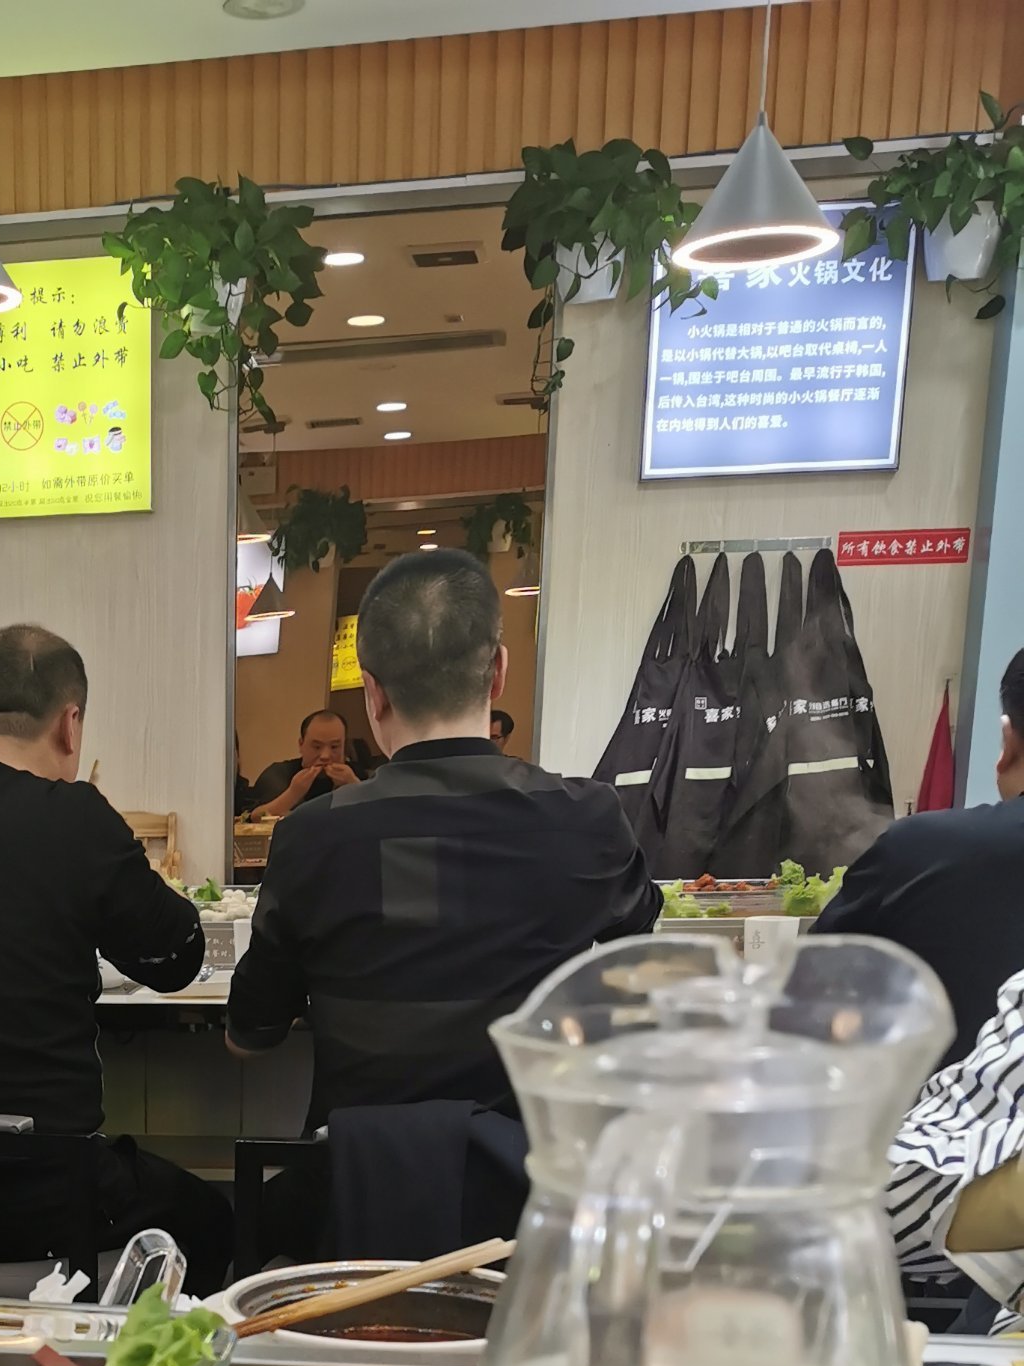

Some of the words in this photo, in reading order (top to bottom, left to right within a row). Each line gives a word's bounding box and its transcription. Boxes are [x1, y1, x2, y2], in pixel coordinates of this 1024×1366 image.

[52, 347, 129, 372] 禁止外带
[841, 536, 966, 557] 所有饮食禁止外带
